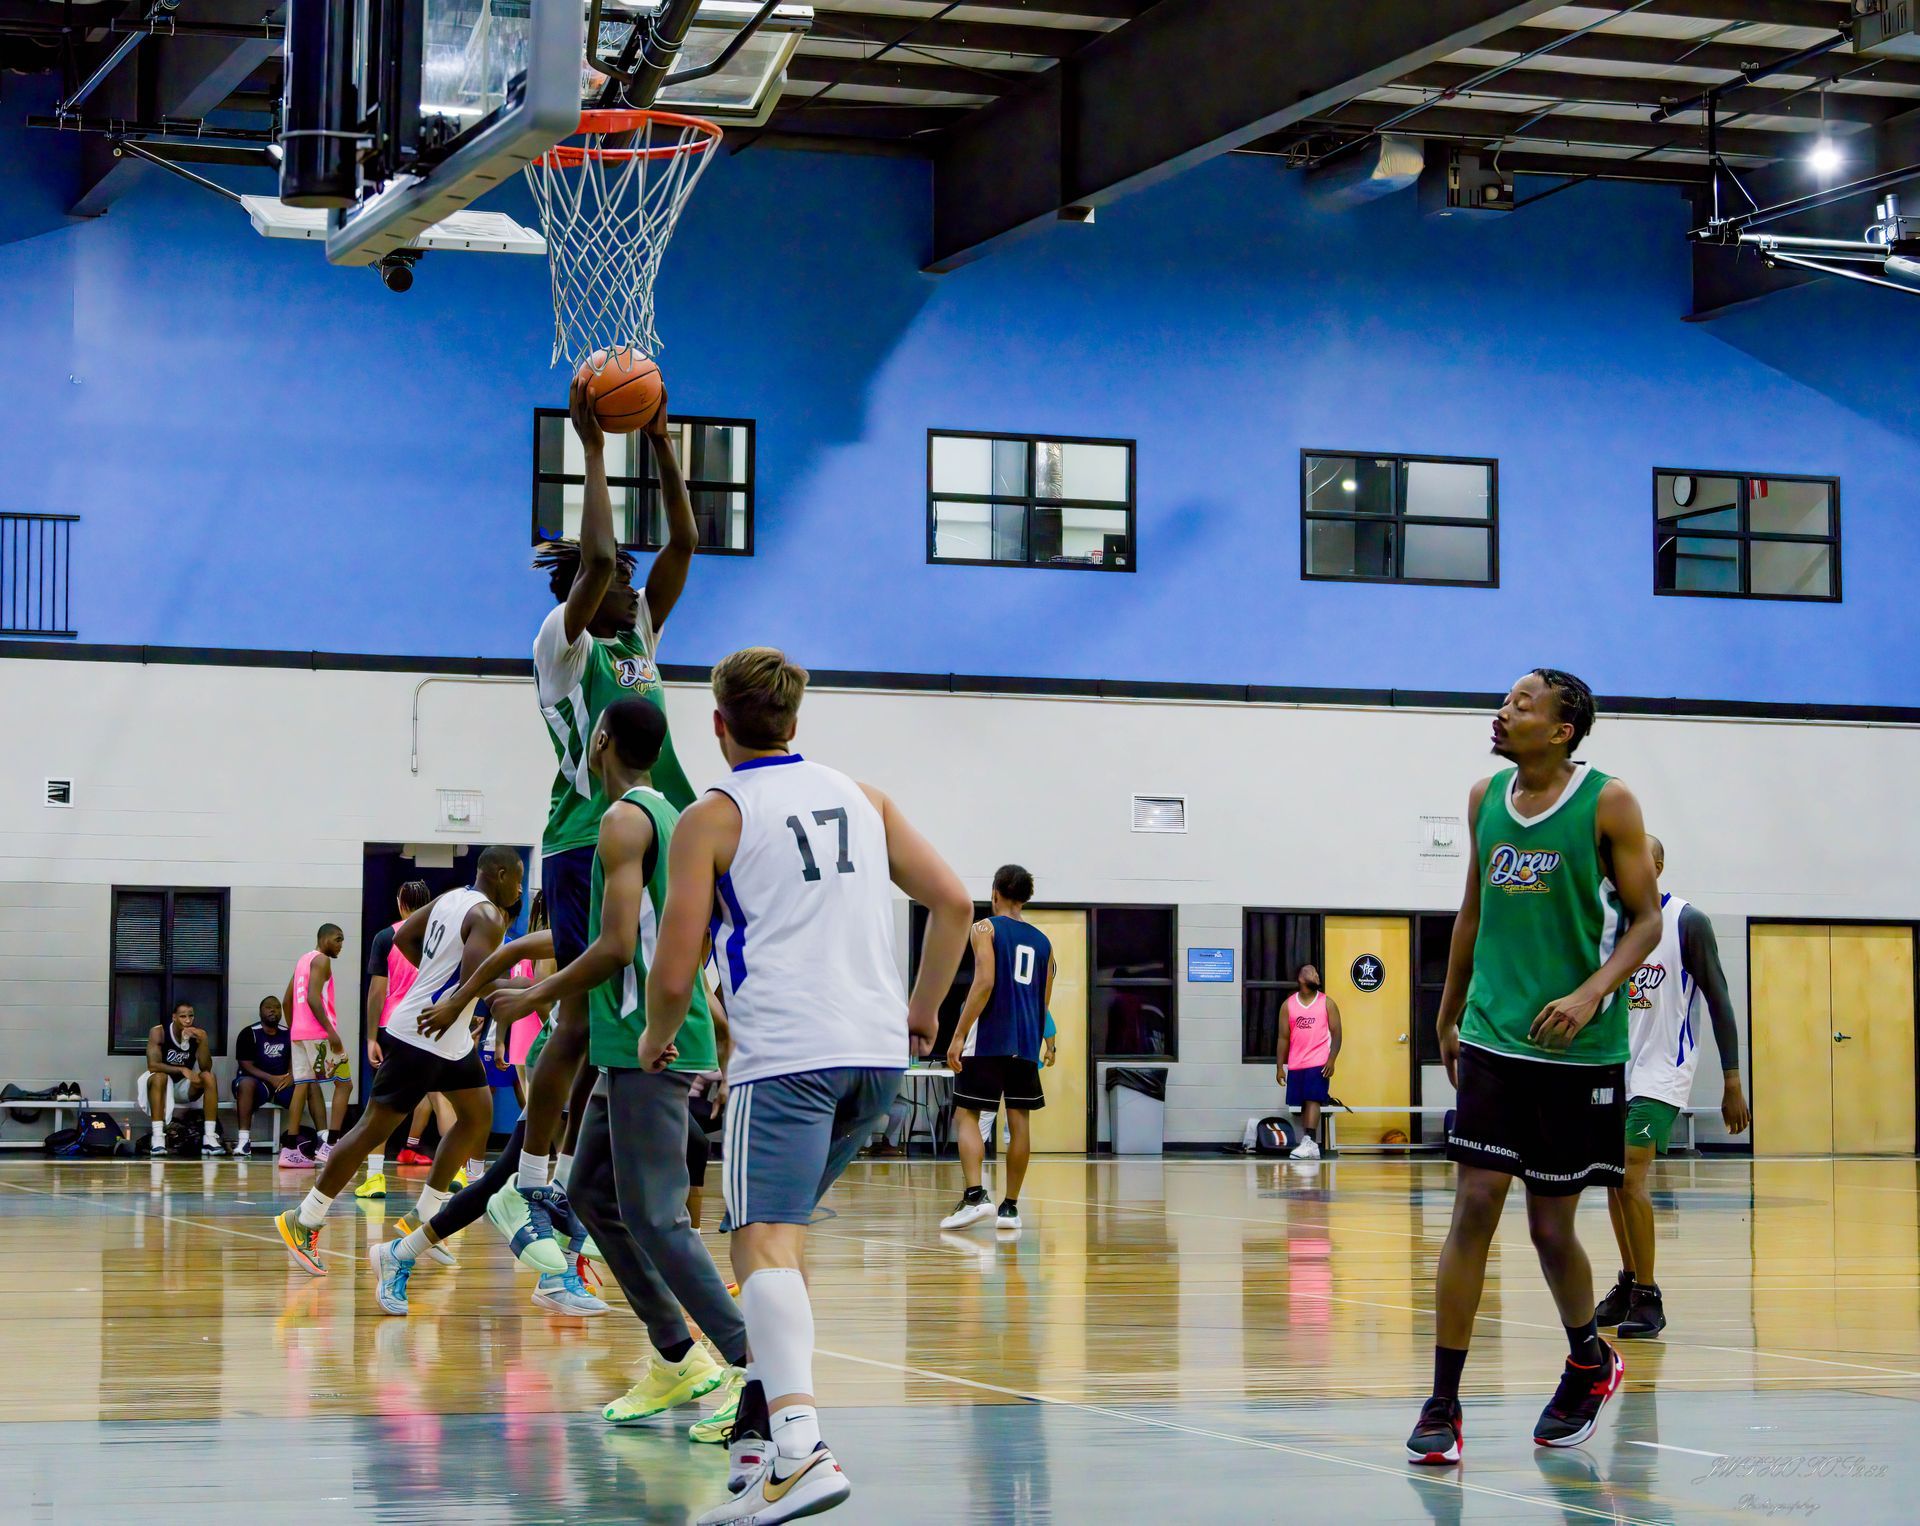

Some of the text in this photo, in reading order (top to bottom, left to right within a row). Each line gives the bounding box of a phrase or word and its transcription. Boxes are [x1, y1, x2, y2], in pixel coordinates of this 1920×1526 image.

[786, 807, 855, 882] 17
[1491, 844, 1560, 885] Drew
[1014, 944, 1035, 985] 0
